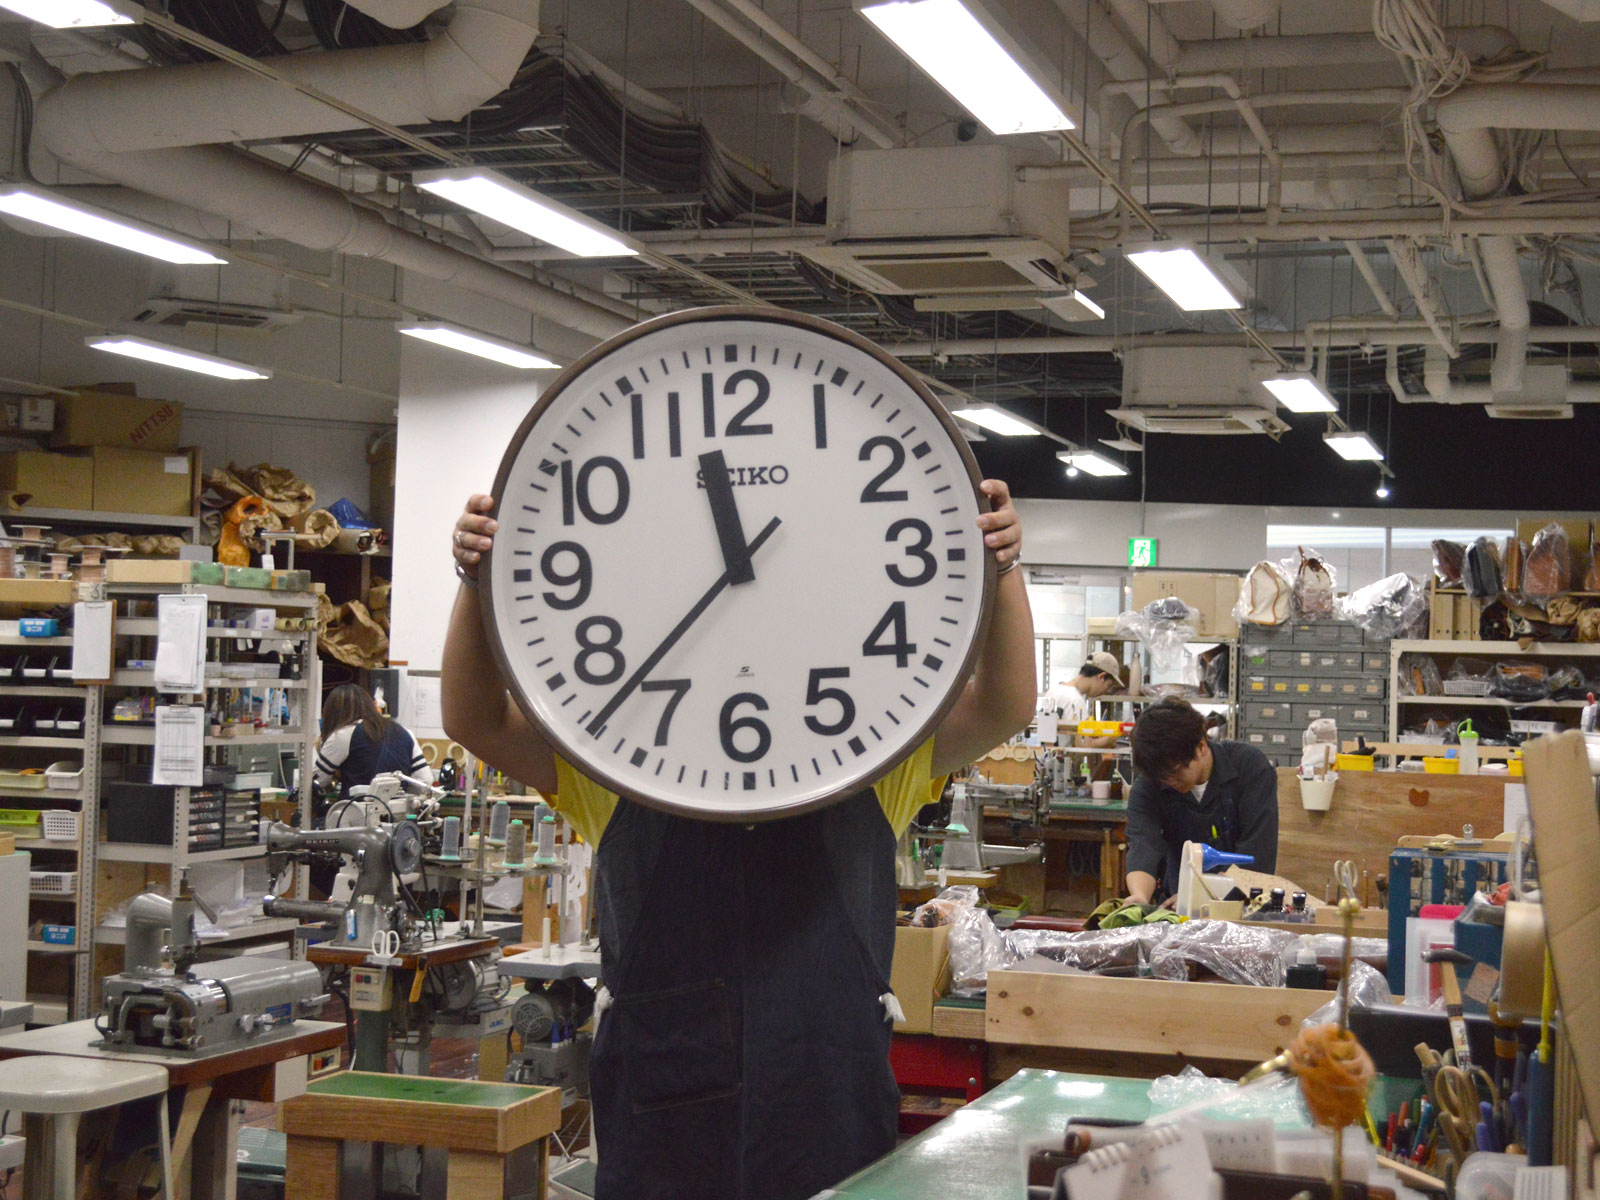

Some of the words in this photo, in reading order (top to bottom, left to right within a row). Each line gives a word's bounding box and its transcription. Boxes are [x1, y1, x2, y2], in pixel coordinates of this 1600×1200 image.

[129, 404, 173, 443] NITTSU
[630, 391, 682, 460] 11
[701, 368, 773, 438] 12
[812, 383, 828, 450] 1
[560, 455, 631, 526] 10
[858, 435, 909, 504] 2
[540, 540, 593, 611] 9
[884, 517, 938, 588] 3
[573, 615, 626, 686] 8
[862, 600, 917, 669] 4
[640, 678, 692, 747] 7
[718, 691, 772, 764] 6
[803, 666, 856, 737] 5
